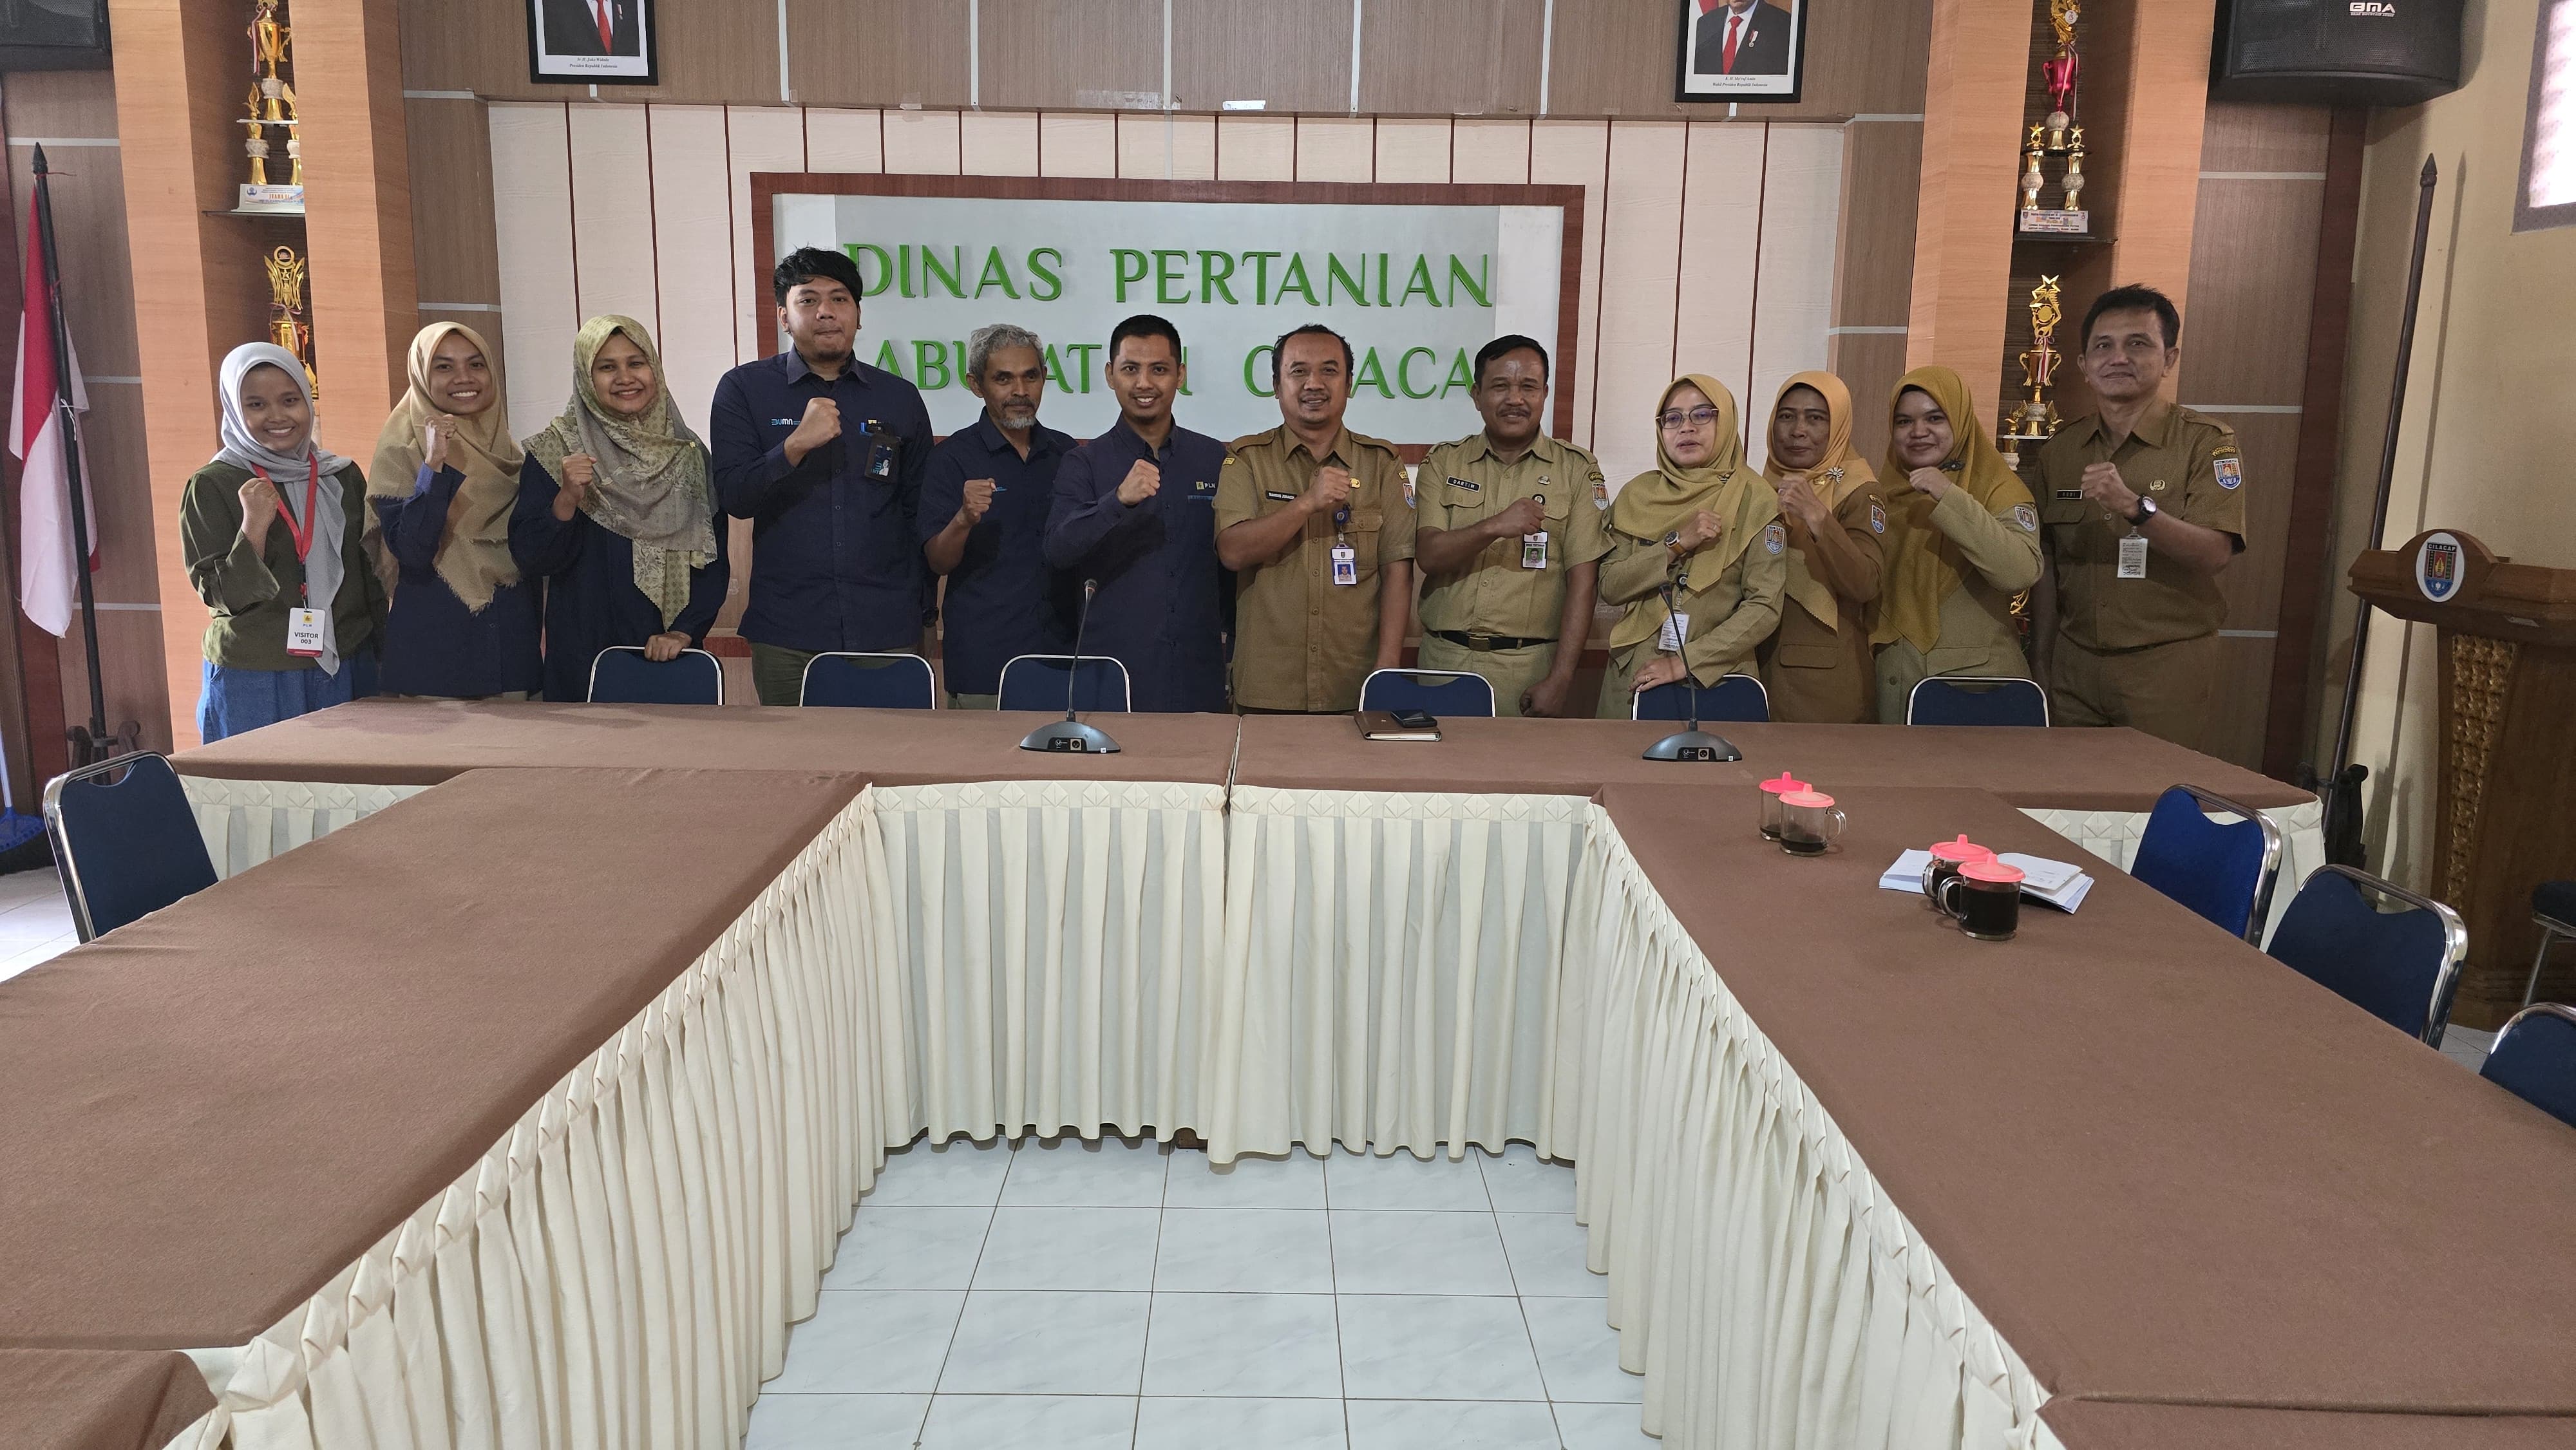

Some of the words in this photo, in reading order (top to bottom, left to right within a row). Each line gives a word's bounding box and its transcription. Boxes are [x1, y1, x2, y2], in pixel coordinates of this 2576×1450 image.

[843, 243, 1063, 301] DINAS
[1110, 248, 1493, 308] PERTANIAN
[1244, 344, 1475, 400] CACA
